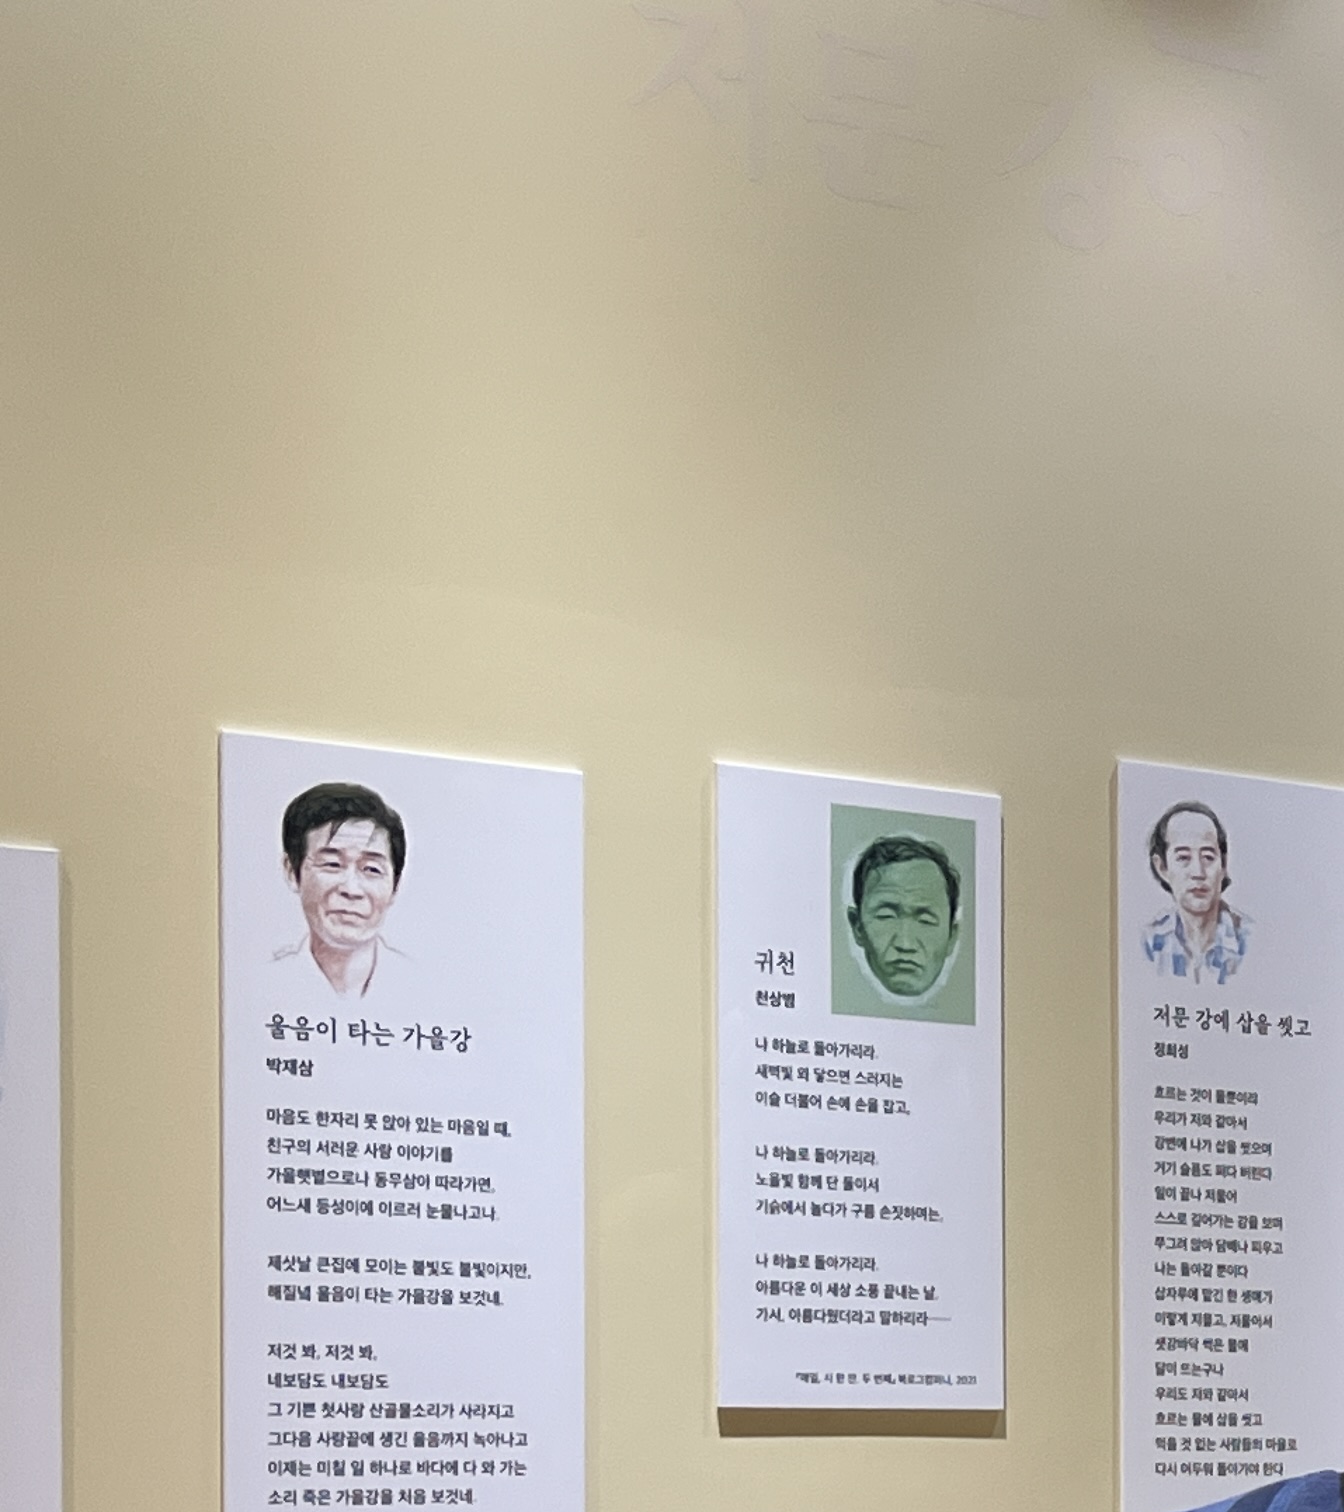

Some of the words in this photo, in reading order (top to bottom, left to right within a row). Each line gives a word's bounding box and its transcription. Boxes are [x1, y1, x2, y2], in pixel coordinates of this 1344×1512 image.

[755, 948, 795, 976] 귀천
[755, 990, 795, 1009] 천상병
[1154, 1004, 1190, 1029] 저문
[1196, 1007, 1229, 1032] 강에
[1236, 1011, 1272, 1036] 삽을
[1277, 1015, 1311, 1037] 씻고
[265, 1013, 336, 1044] 울음이
[348, 1018, 395, 1047] 타는
[403, 1023, 472, 1053] 가을강
[266, 1056, 314, 1077] 박재삼
[267, 1108, 311, 1126] 마음도
[316, 1110, 358, 1129] 한자리
[364, 1113, 378, 1131] 못
[382, 1114, 411, 1132] 앉아
[415, 1117, 444, 1134] 있는
[448, 1118, 489, 1137] 마음일
[494, 1121, 511, 1138] 때,
[268, 1136, 311, 1156] 친구의
[316, 1140, 359, 1158] 서러운
[364, 1142, 392, 1160] 사랑
[435, 1175, 495, 1194] 따라가면,
[267, 1195, 311, 1214] 어느새
[316, 1197, 374, 1217] 등성이에
[379, 1200, 420, 1219] 이르러
[426, 1203, 496, 1222] 눈물나고나.
[268, 1254, 311, 1273] 제삿날
[317, 1257, 360, 1274] 큰집에
[365, 1258, 407, 1275] 모이는
[412, 1260, 454, 1277] 불빛도
[459, 1261, 531, 1279] 불빛이지만,
[316, 1285, 360, 1303] 울음이
[365, 1287, 393, 1304] 타는
[398, 1287, 454, 1305] 가을강을
[459, 1289, 503, 1306] 보것네.
[268, 1343, 296, 1360] 저것
[301, 1343, 320, 1360] 봐,
[325, 1344, 354, 1361] 저것
[359, 1344, 377, 1361] 봐,
[268, 1372, 327, 1390] 네보담도
[331, 1373, 389, 1390] 내보담도
[268, 1402, 282, 1416] 그
[287, 1401, 316, 1418] 기쁜
[321, 1402, 365, 1419] 첫사랑
[369, 1402, 455, 1419] 산골물소리가
[459, 1403, 514, 1420] 사라지고
[268, 1431, 312, 1448] 그다음
[317, 1430, 374, 1448] 사랑끝에
[379, 1431, 407, 1448] 생긴
[413, 1431, 468, 1449] 울음까지
[473, 1432, 528, 1449] 녹아나고
[268, 1459, 312, 1477] 이제는
[317, 1459, 346, 1477] 미칠
[351, 1460, 364, 1477] 일
[370, 1460, 412, 1477] 하나로
[417, 1459, 458, 1477] 바다에
[463, 1459, 477, 1476] 다
[481, 1459, 495, 1476] 와
[500, 1459, 527, 1476] 가는
[268, 1489, 297, 1506] 소리
[303, 1489, 331, 1506] 죽은
[336, 1488, 393, 1506] 가을강을
[398, 1488, 426, 1505] 처음
[431, 1488, 473, 1505] 보것네.
